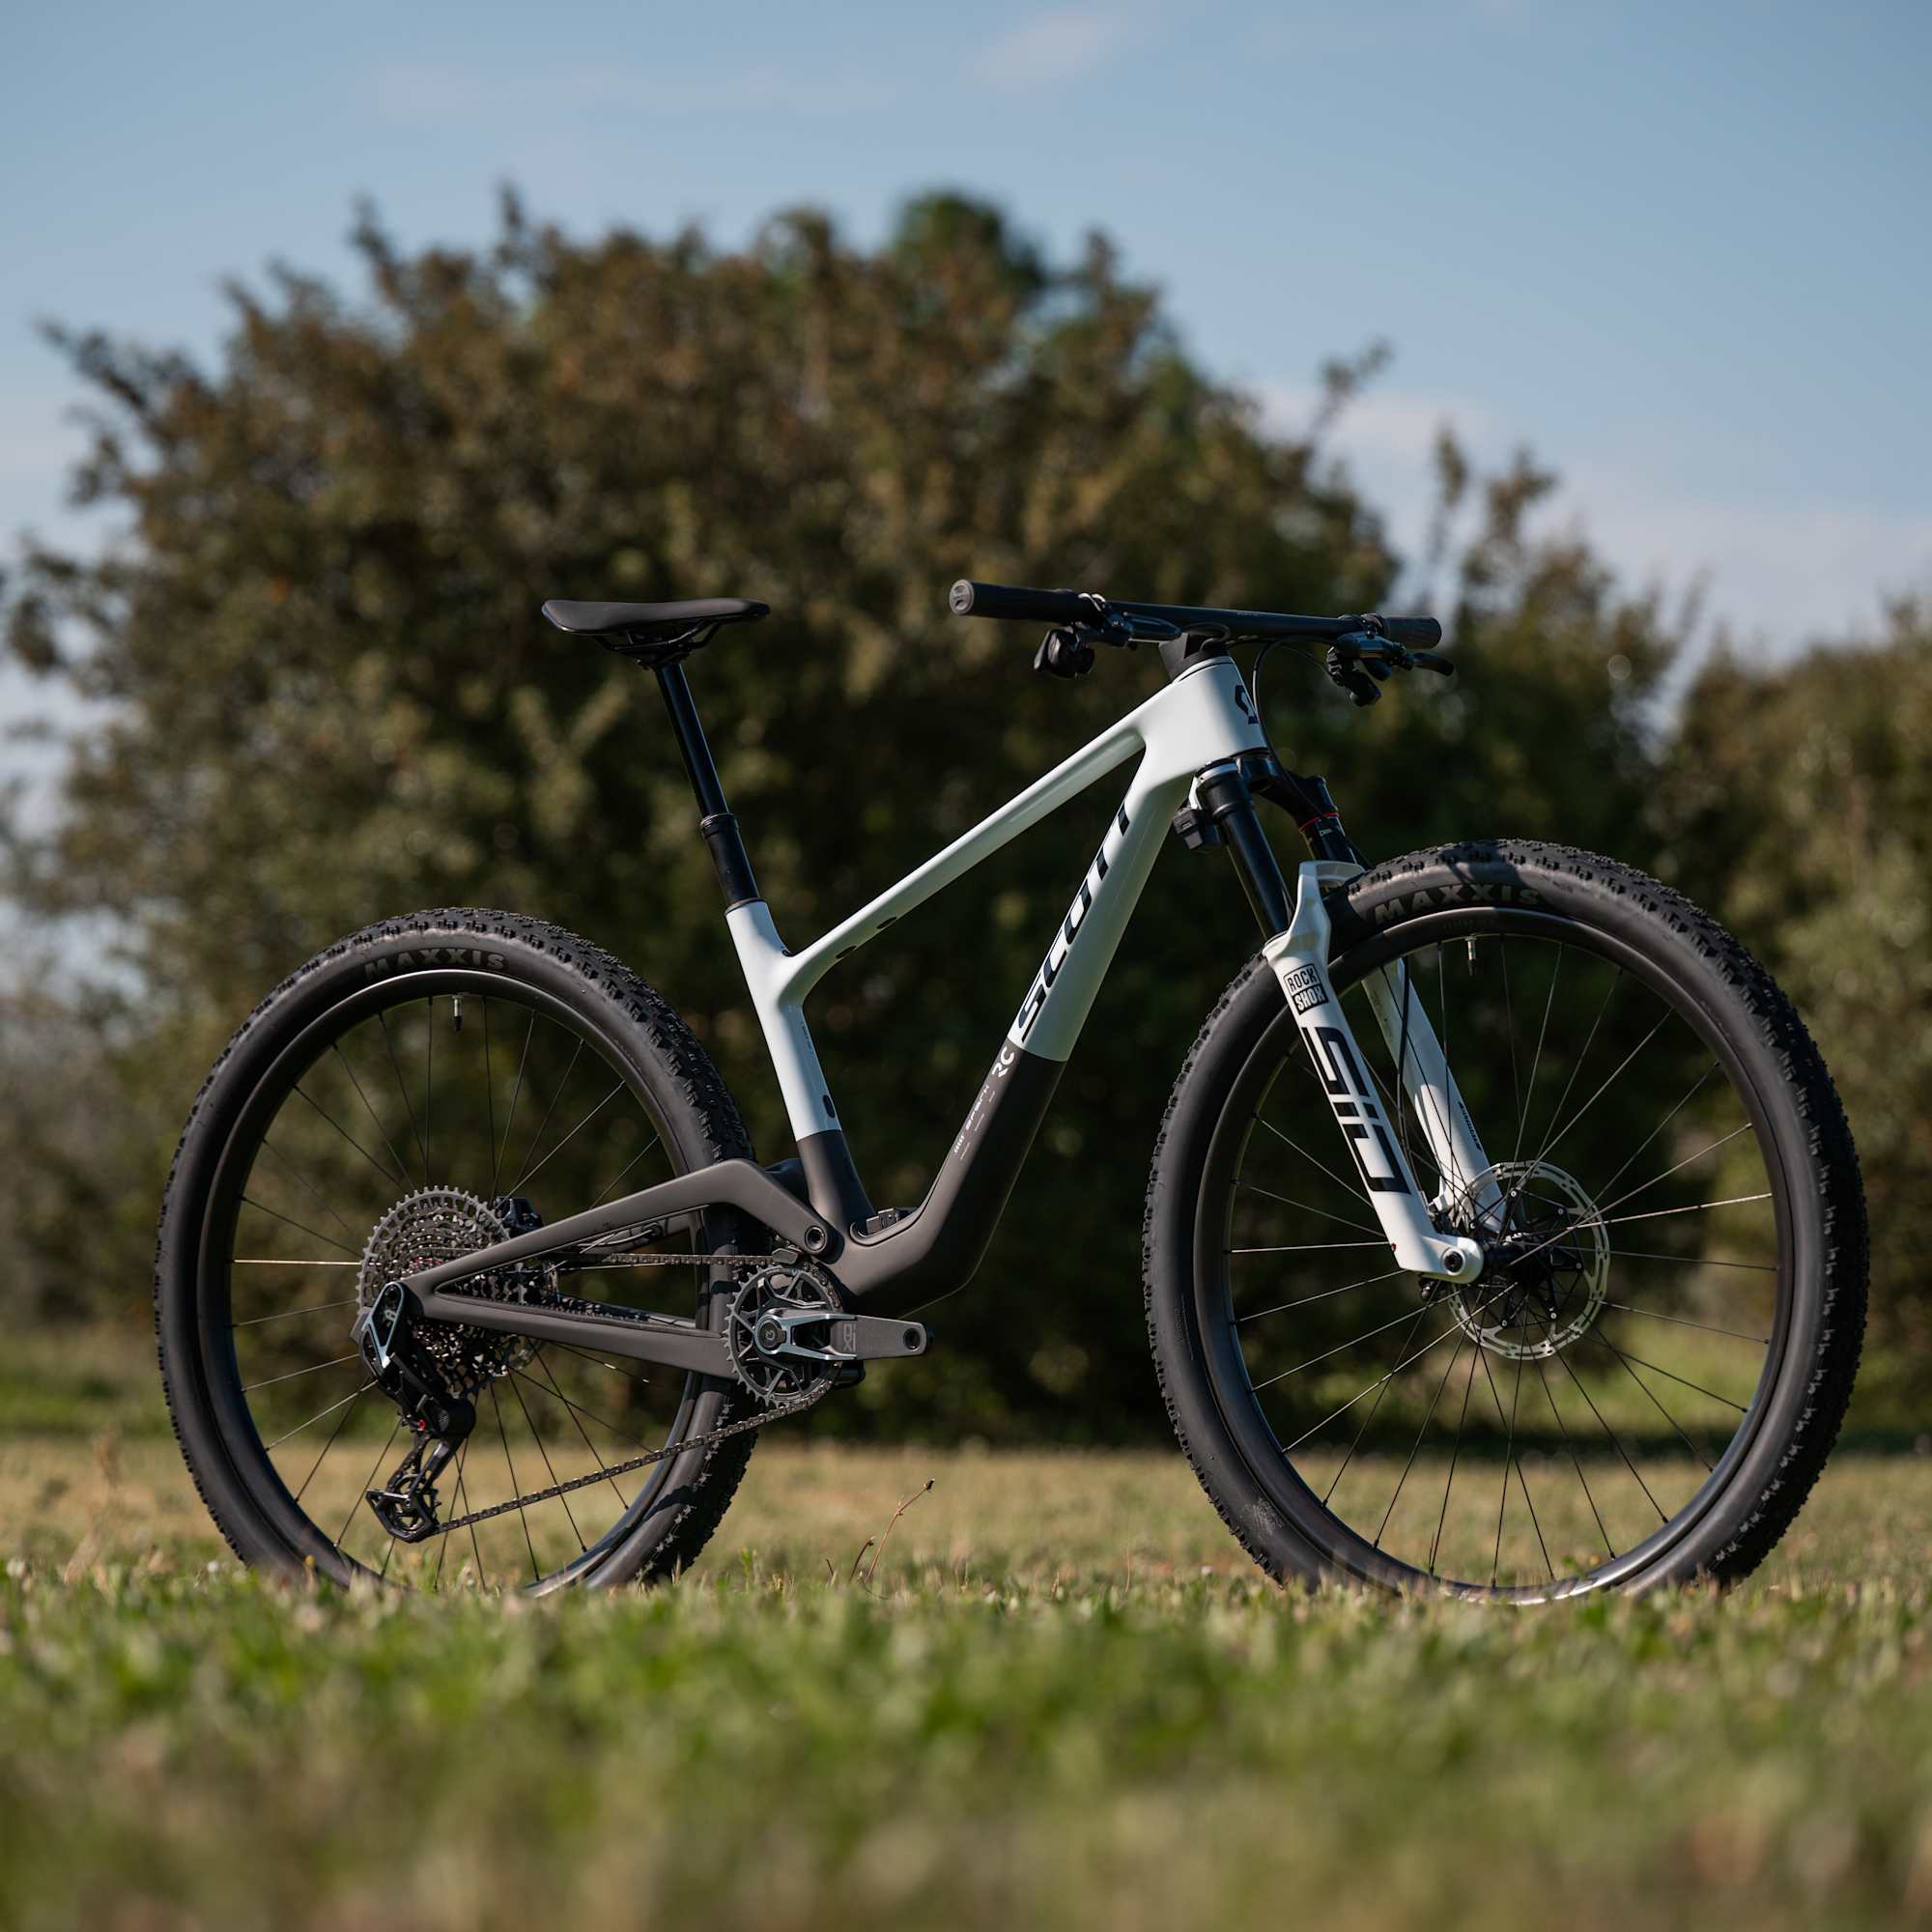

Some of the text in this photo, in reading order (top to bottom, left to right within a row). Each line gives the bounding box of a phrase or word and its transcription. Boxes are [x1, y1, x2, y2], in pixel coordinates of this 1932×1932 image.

[1374, 884, 1540, 924] MAXXIS
[364, 948, 506, 981] MAXXIS
[1287, 967, 1318, 993] ROCK
[1293, 985, 1326, 1011] SHOX
[991, 1045, 1015, 1078] RC
